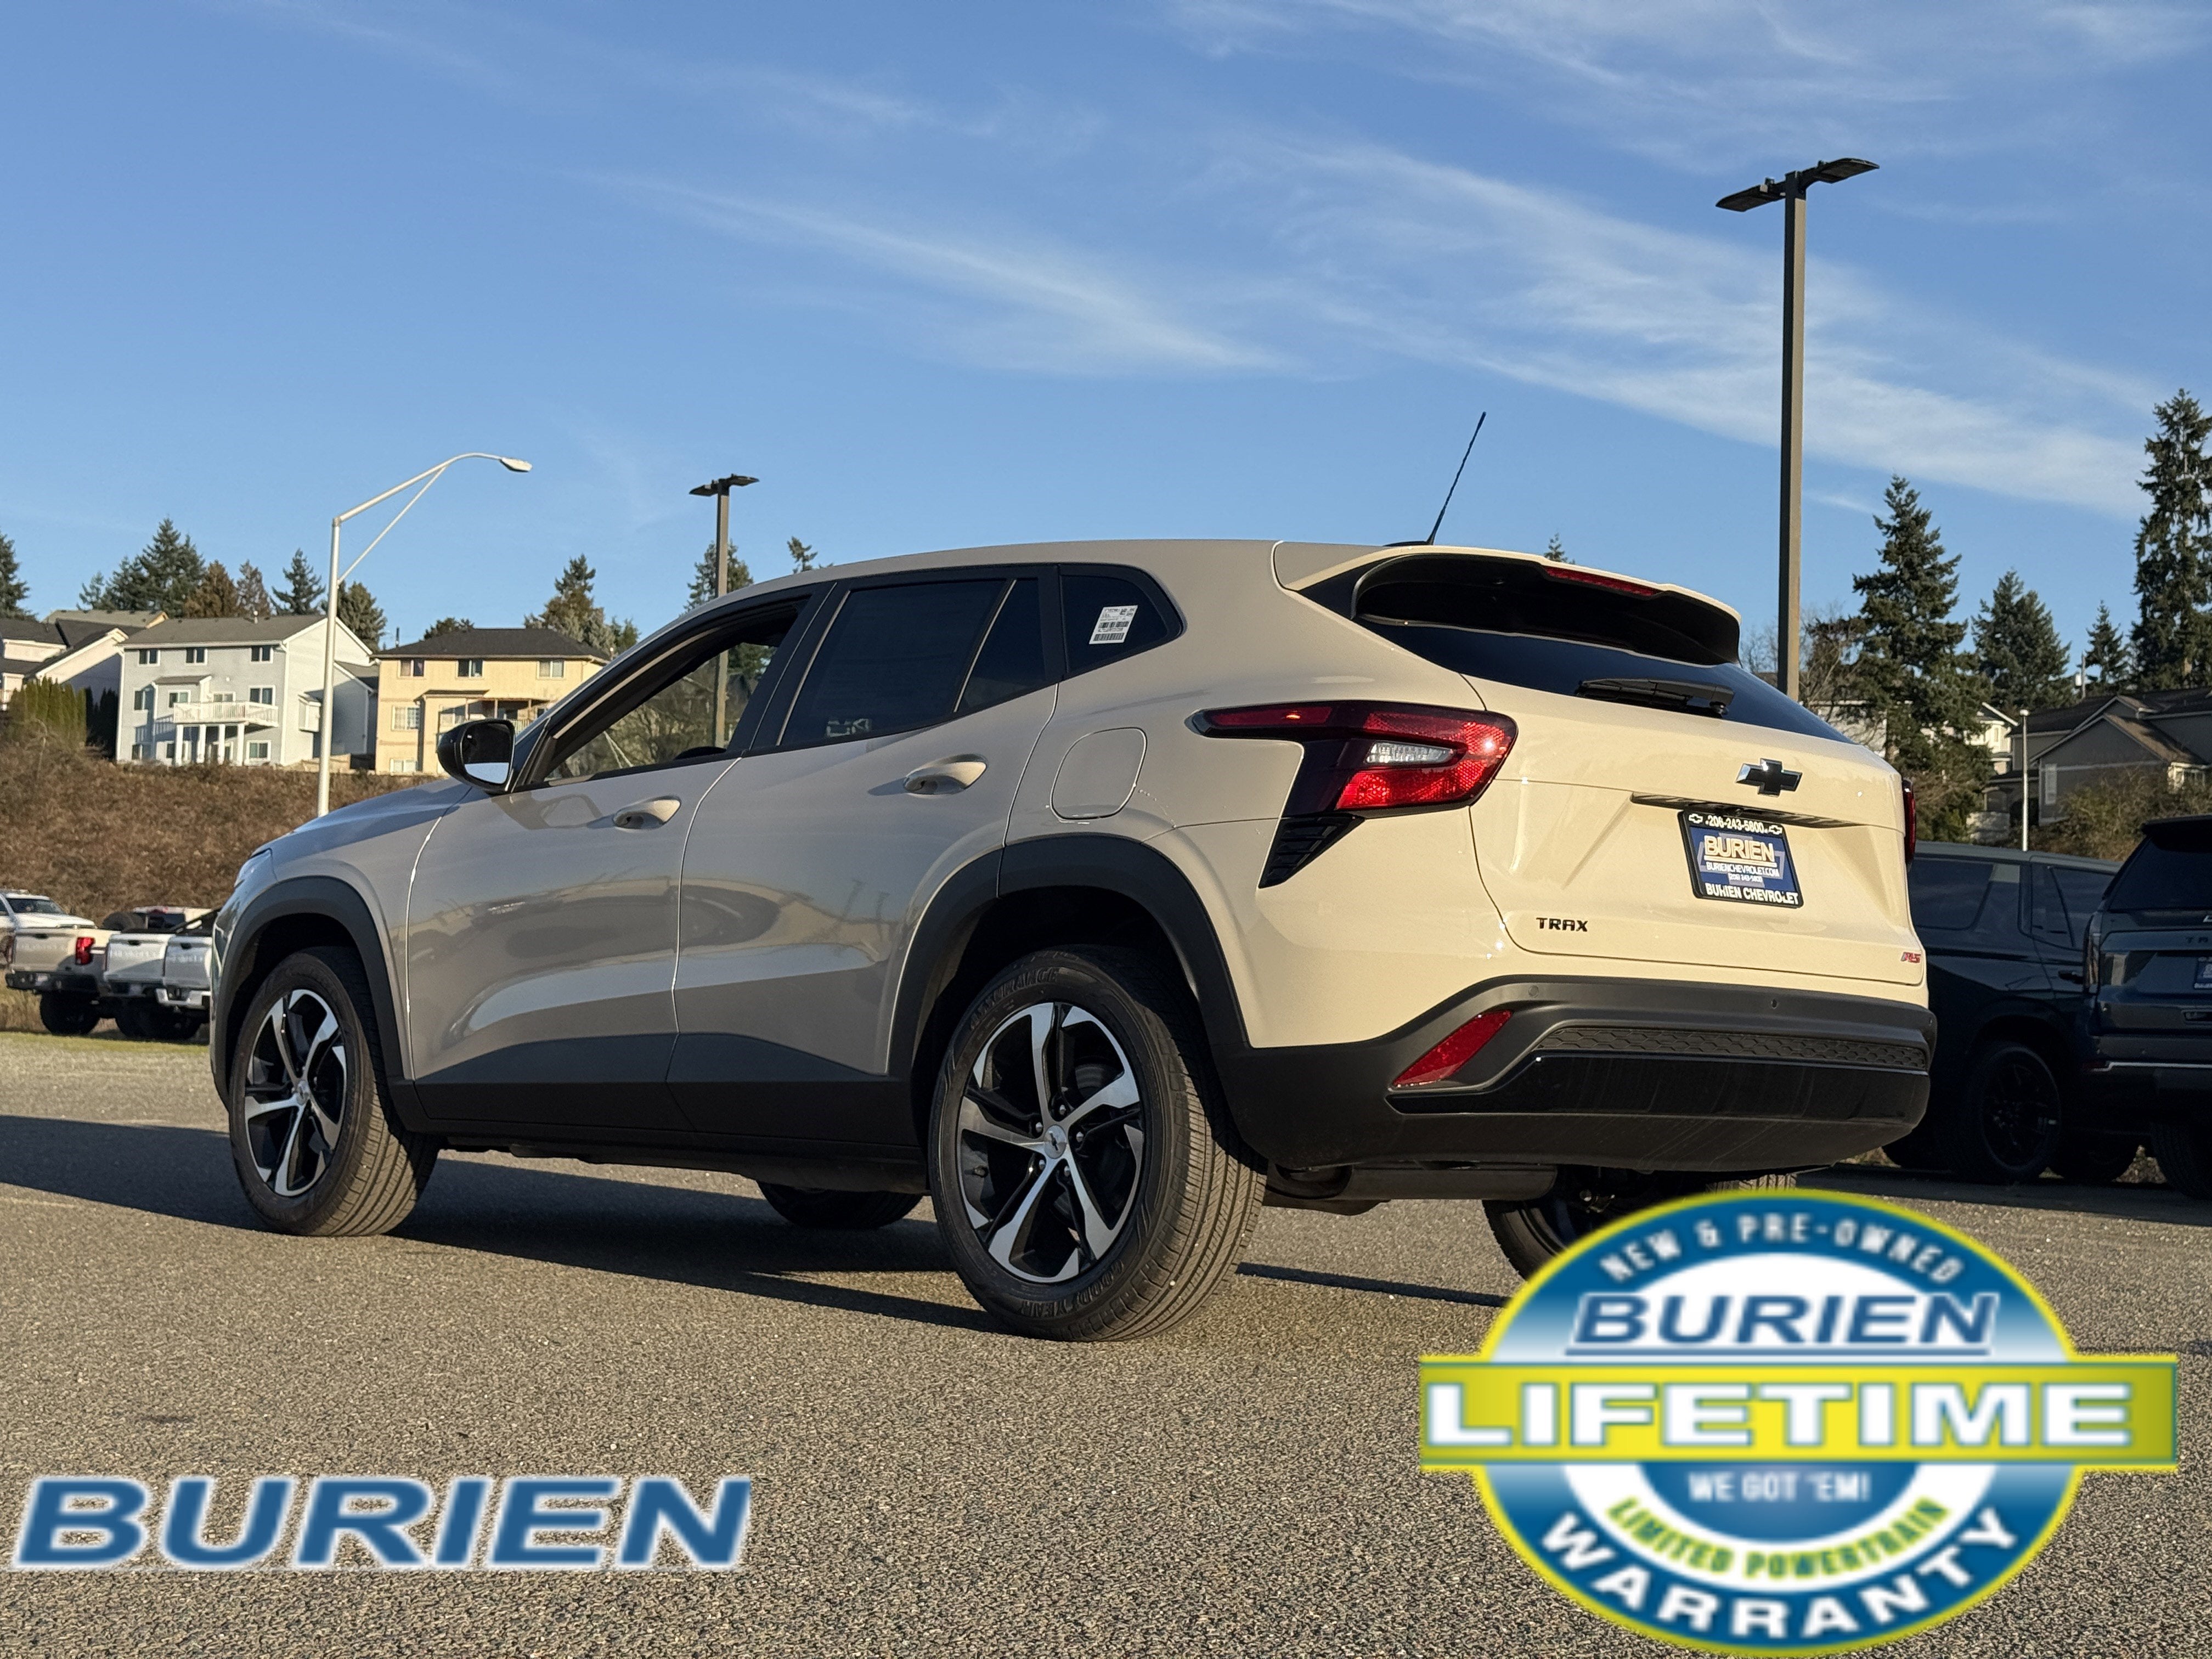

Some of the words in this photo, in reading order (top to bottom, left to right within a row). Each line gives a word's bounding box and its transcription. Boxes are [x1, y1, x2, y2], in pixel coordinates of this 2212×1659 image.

[1704, 836, 1775, 862] BURIEN
[1743, 887, 1799, 905] CHEVROLET
[1536, 917, 1588, 932] TRAX
[1900, 952, 1921, 963] RS
